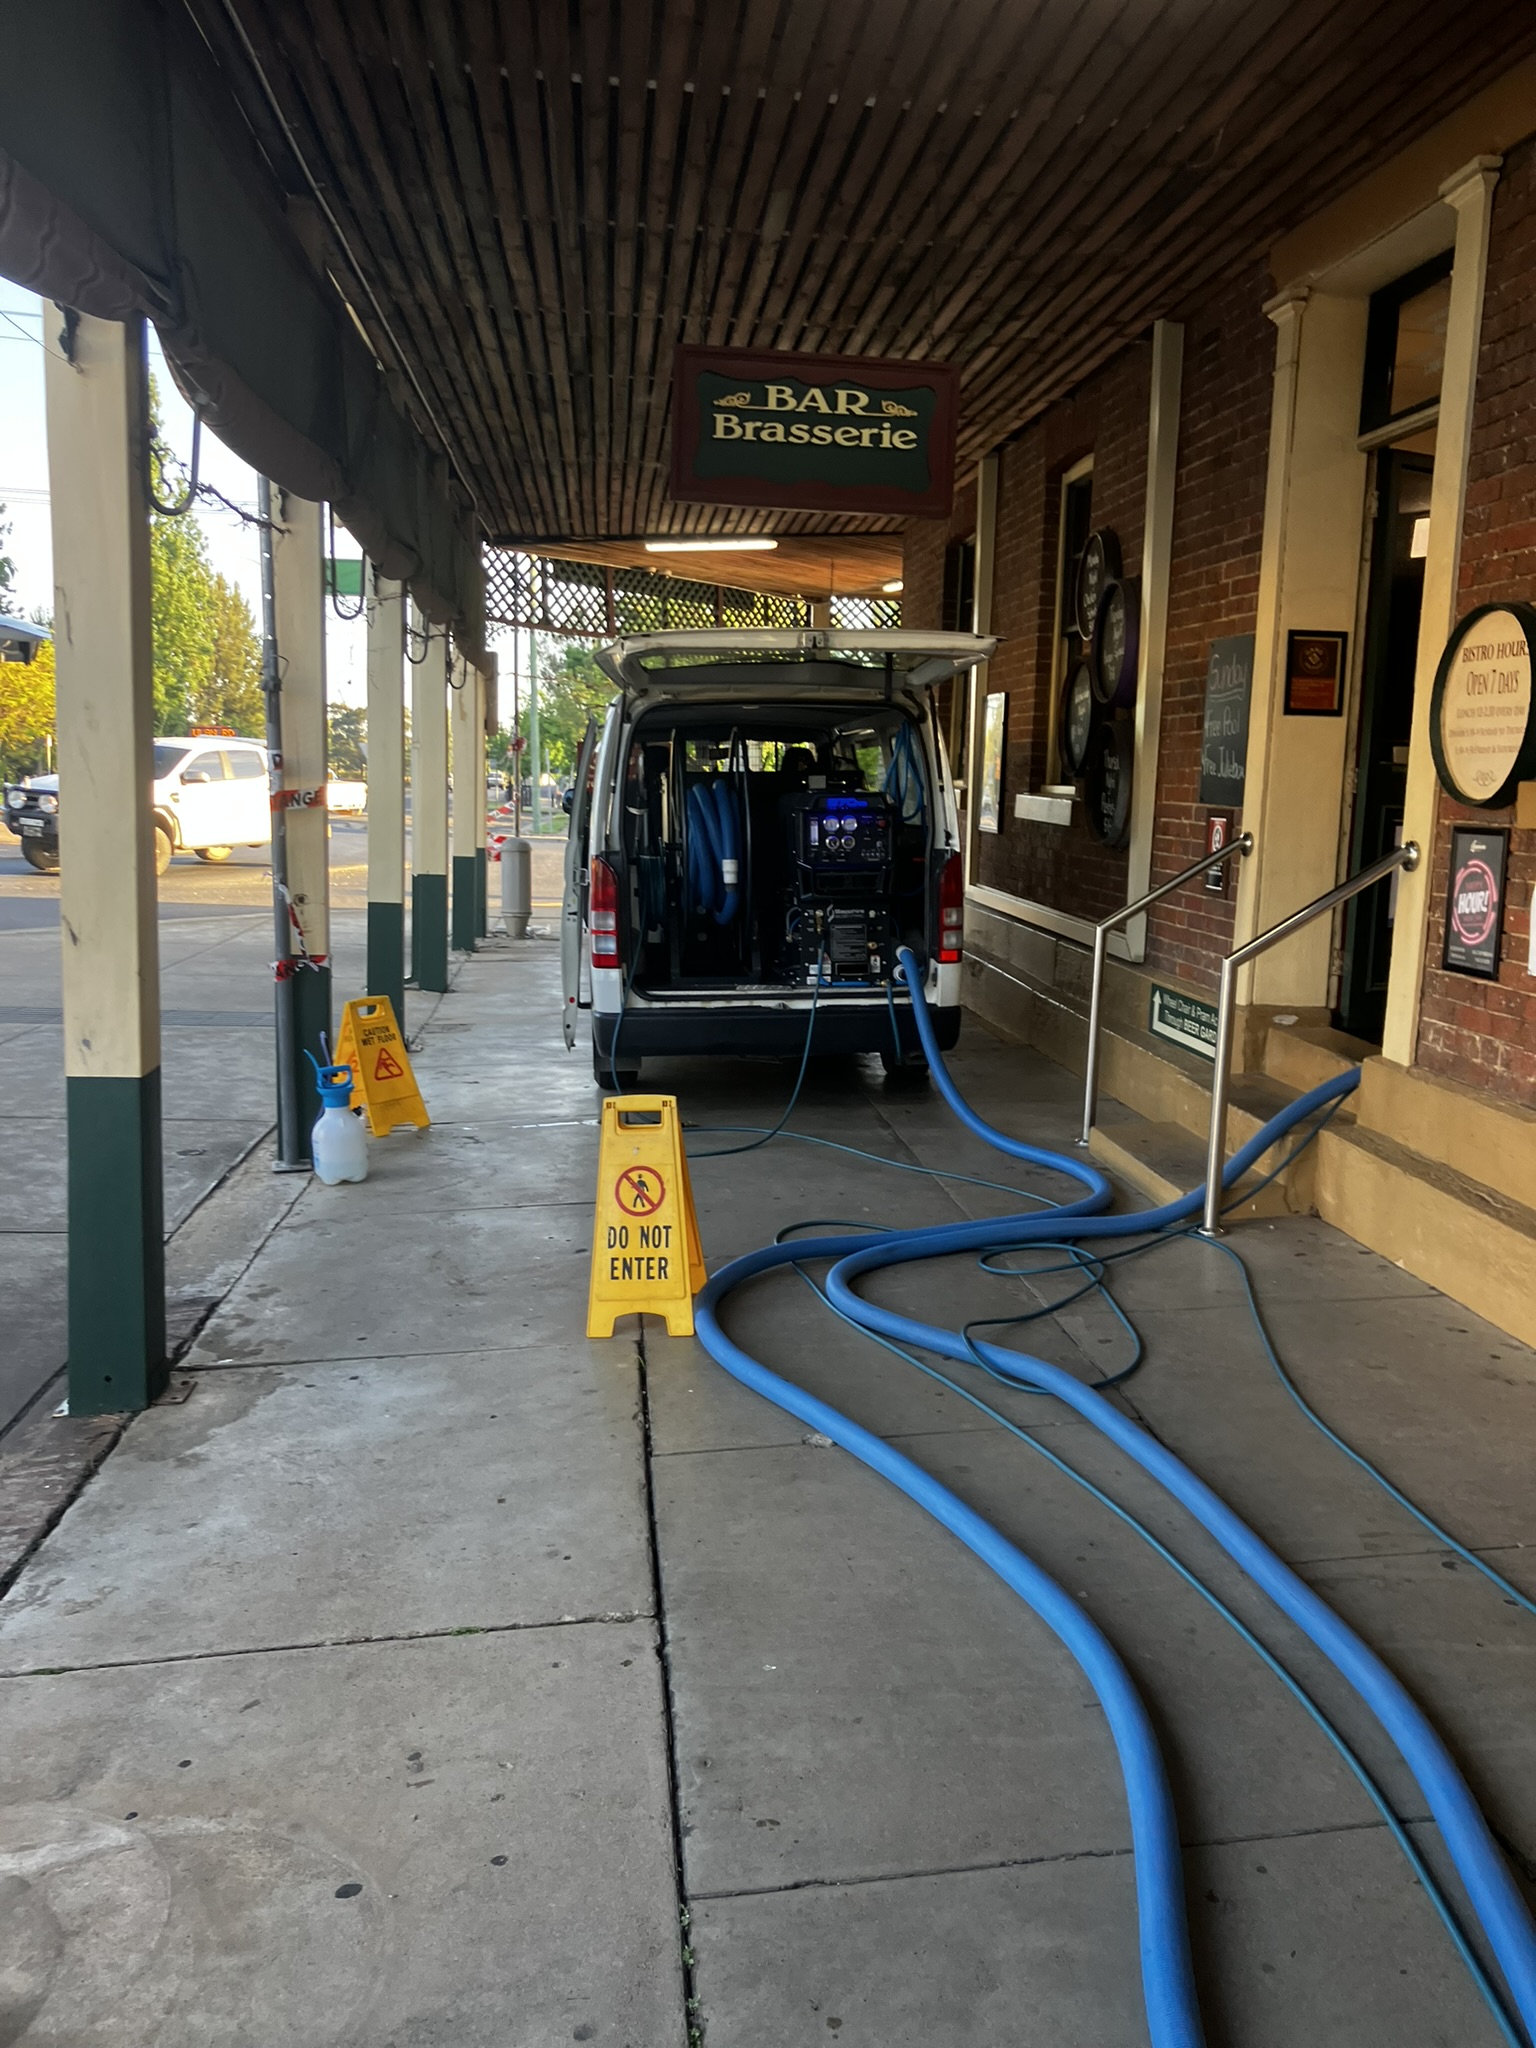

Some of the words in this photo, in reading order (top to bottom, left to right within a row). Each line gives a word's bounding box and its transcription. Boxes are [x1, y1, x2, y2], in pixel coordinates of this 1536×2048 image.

[764, 385, 869, 415] BAR
[712, 413, 918, 449] Brasserie
[1463, 644, 1494, 663] BISTRO
[1467, 671, 1488, 696] OPEN
[1491, 669, 1497, 694] 7
[1498, 670, 1520, 694] DAYS
[1458, 890, 1489, 914] HOUR!
[363, 1026, 390, 1037] CAUTION
[1183, 1018, 1199, 1036] BEER
[361, 1036, 375, 1046] WET
[377, 1033, 397, 1044] FLOOR
[607, 1225, 629, 1249] DO
[640, 1225, 672, 1249] NOT
[610, 1257, 669, 1281] ENTER
